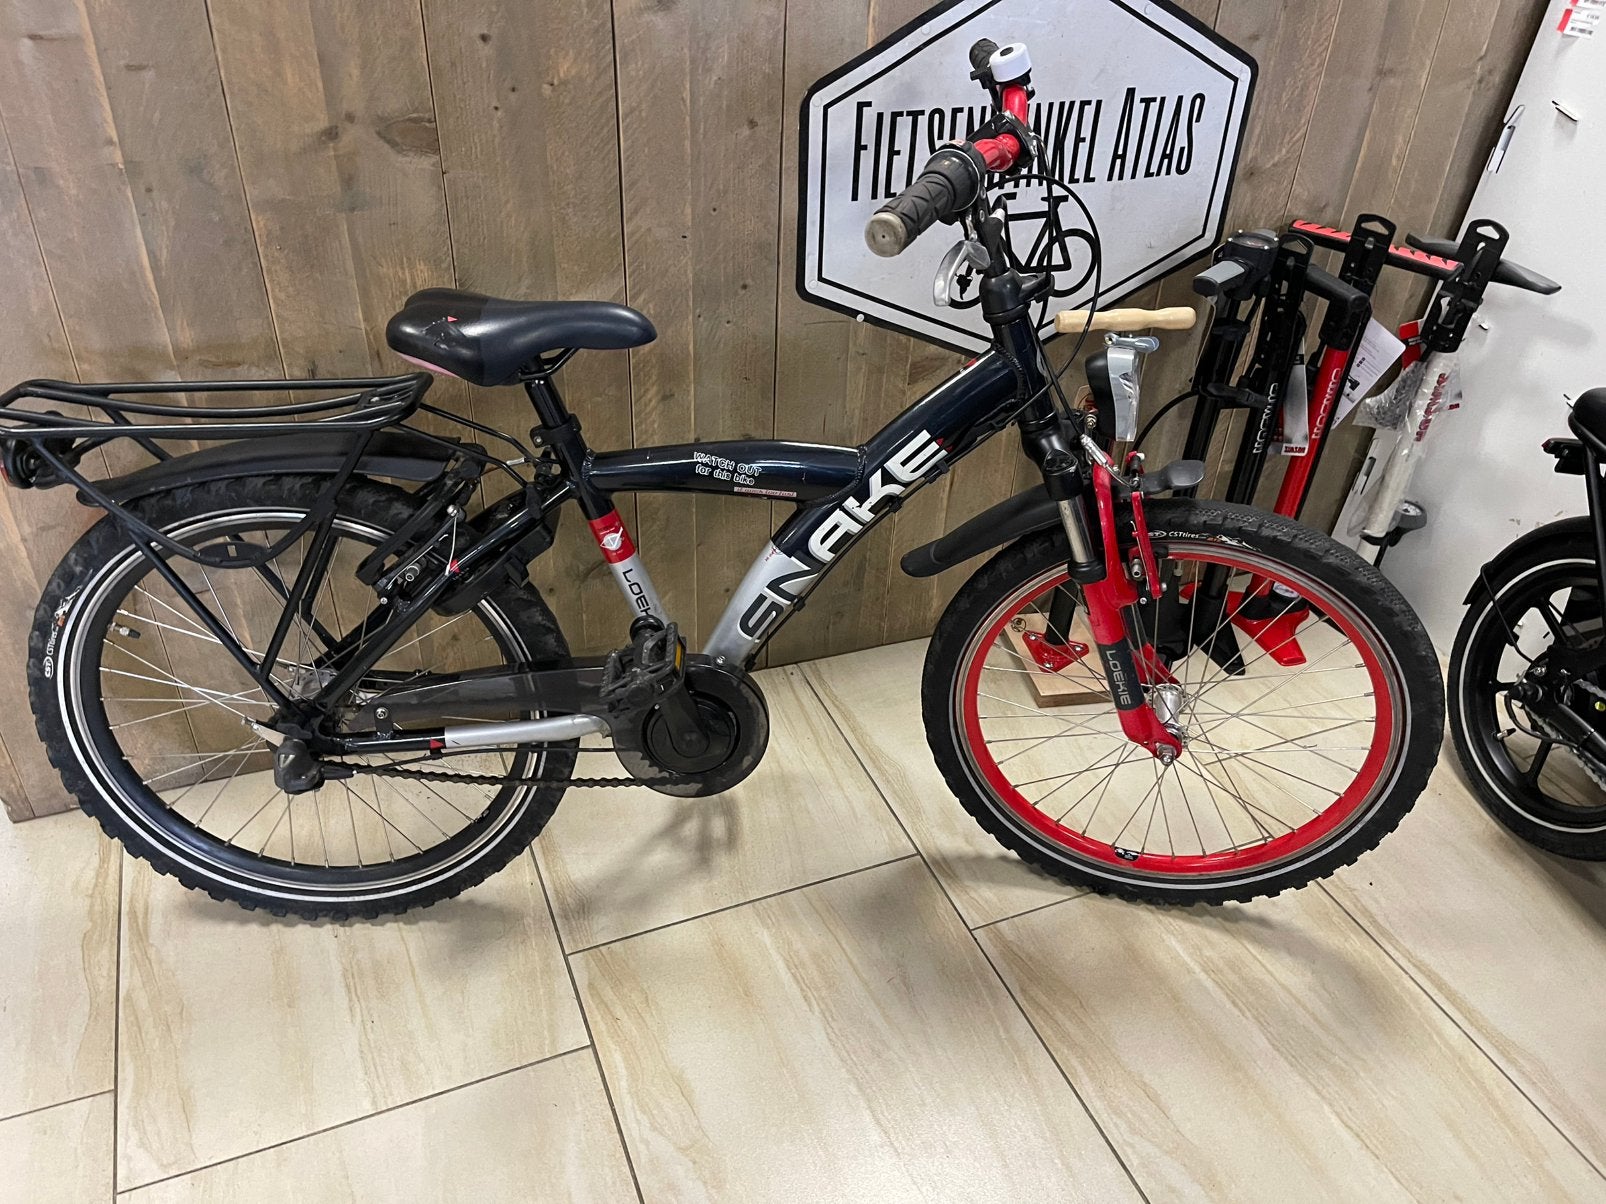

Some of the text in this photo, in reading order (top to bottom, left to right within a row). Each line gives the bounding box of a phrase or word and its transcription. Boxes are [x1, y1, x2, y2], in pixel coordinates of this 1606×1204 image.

[1106, 87, 1206, 182] ATLAS
[693, 451, 762, 476] WATCH OUT
[695, 464, 754, 485] for this bike
[737, 429, 949, 643] SNAKE
[1106, 649, 1132, 706] LOEKIE
